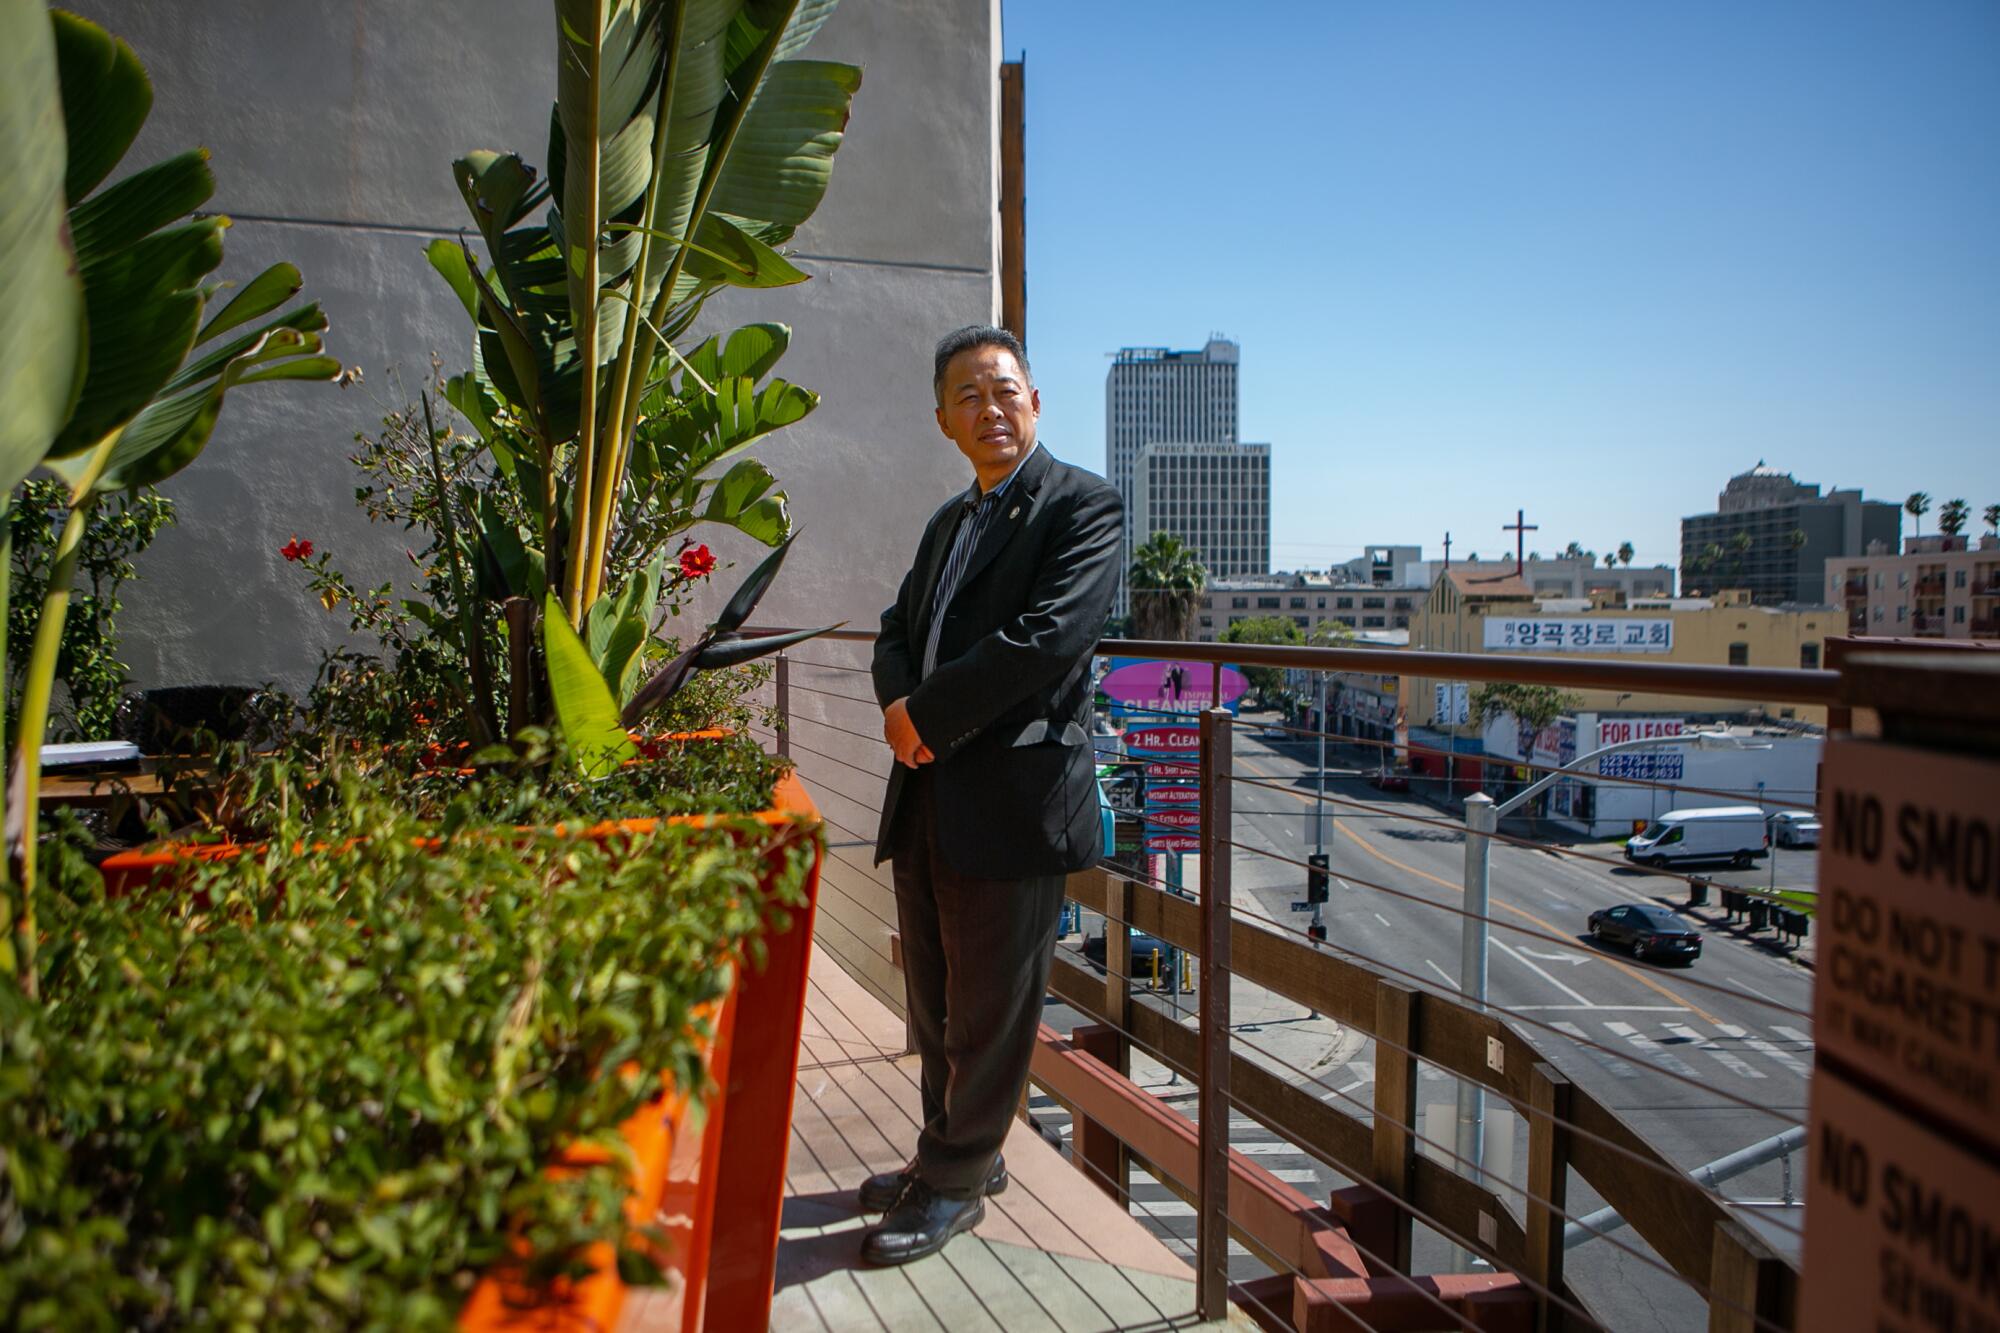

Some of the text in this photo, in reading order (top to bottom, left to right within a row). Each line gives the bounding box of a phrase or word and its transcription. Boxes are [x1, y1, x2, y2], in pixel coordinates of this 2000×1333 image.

[1154, 445, 1264, 454] PIERCE NATIONAL LIFE
[1183, 692, 1232, 700] IMPERAL
[1123, 700, 1213, 713] CLEANER
[1133, 733, 1140, 746] 2
[1601, 723, 1630, 744] FOR
[1833, 788, 2000, 896] NO SMO
[1832, 889, 1879, 944] DO
[1890, 907, 1963, 976] NOT
[1820, 1121, 1869, 1208] NO
